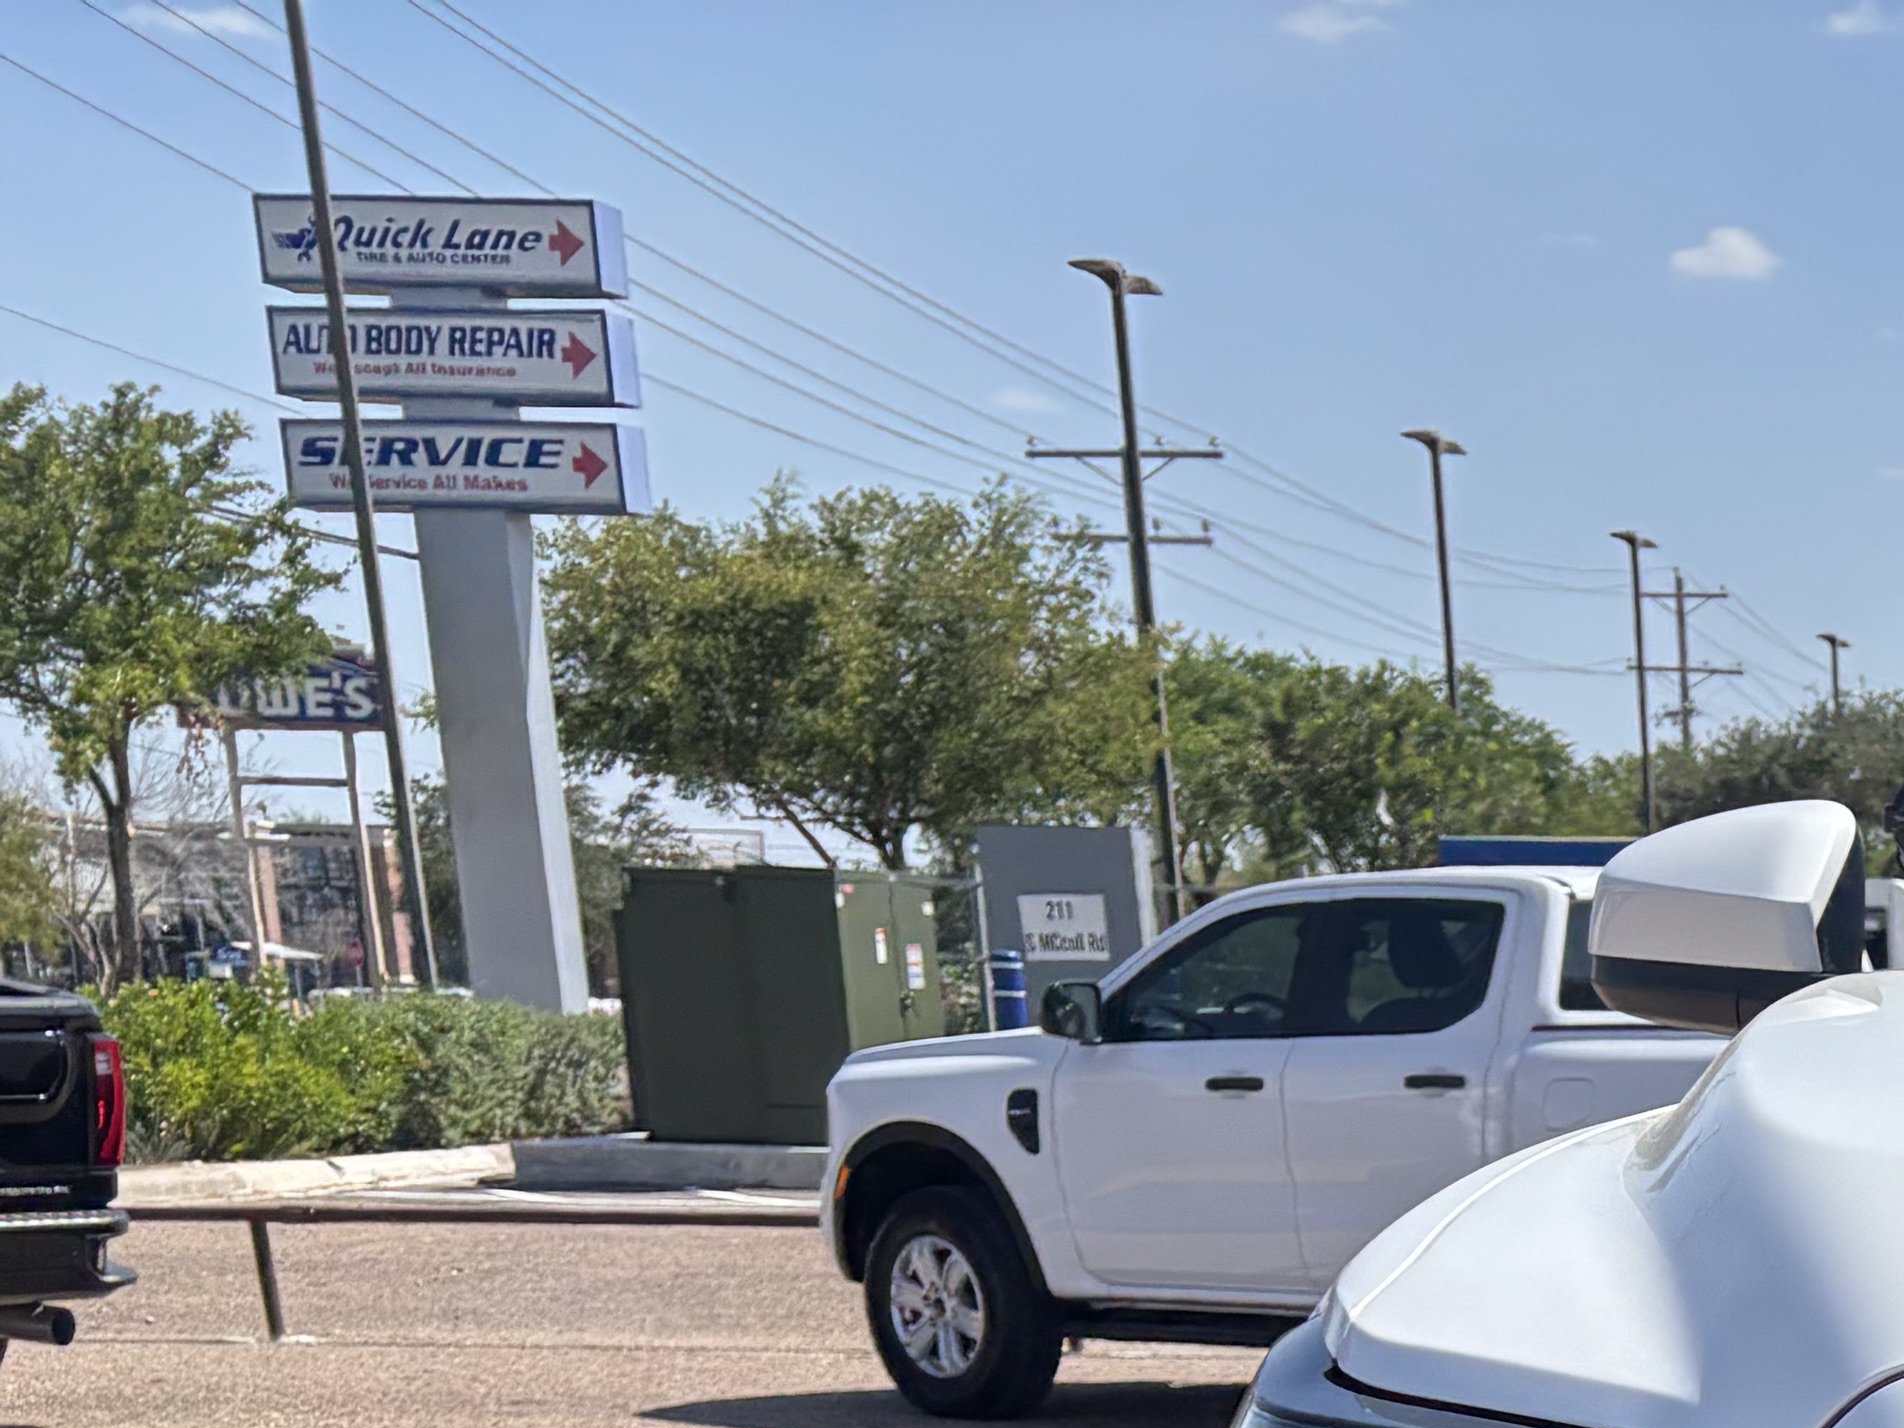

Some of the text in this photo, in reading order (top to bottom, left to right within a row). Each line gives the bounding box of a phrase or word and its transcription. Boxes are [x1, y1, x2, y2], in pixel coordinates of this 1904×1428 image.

[441, 218, 543, 252] Lane
[406, 252, 446, 265] AUTO
[449, 253, 512, 265] CENTER
[364, 324, 442, 356] BODY
[448, 326, 556, 359] REPAIR
[353, 362, 400, 377] ccept
[432, 474, 457, 491] All
[217, 670, 383, 719] OWE'S
[1046, 901, 1074, 920] 211
